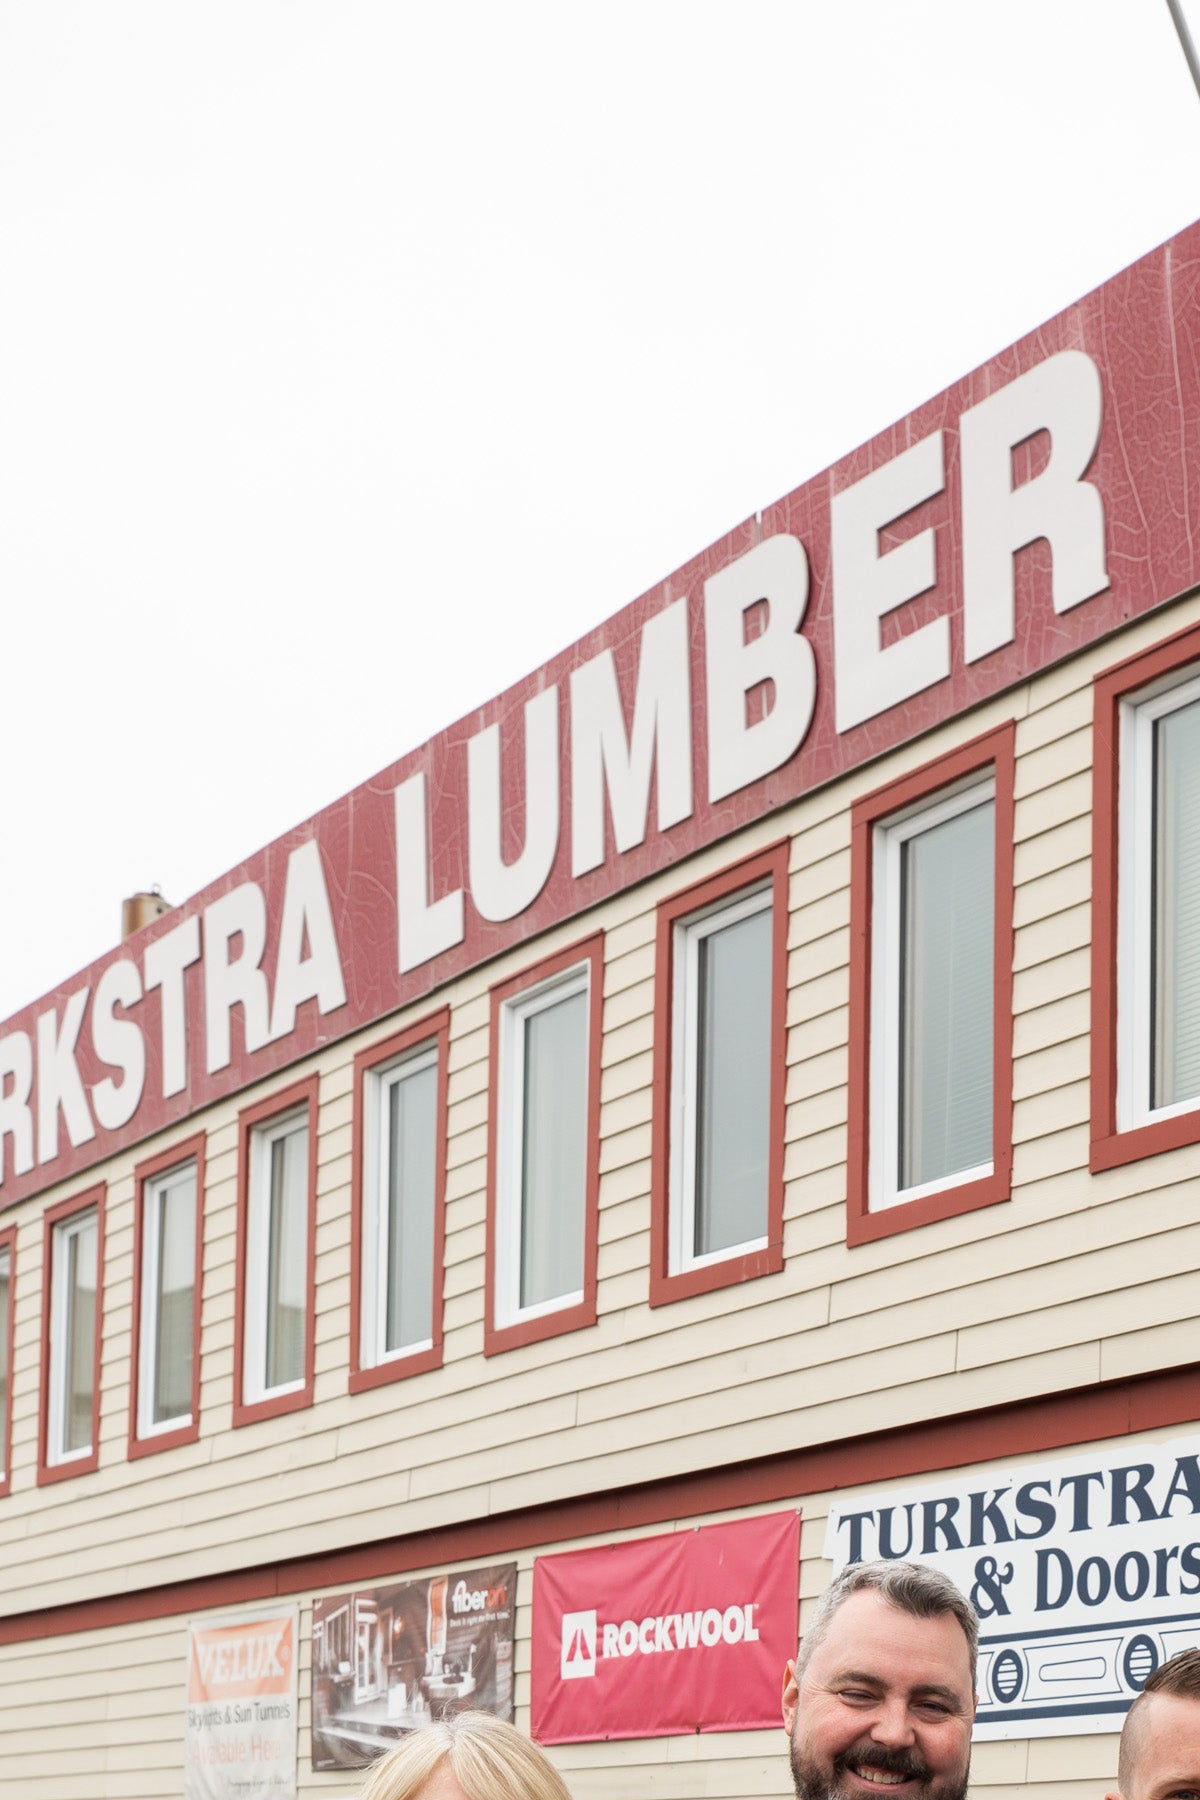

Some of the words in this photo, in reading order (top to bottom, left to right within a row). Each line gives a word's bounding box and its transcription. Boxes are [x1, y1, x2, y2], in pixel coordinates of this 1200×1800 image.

[394, 348, 1111, 975] LUMBER
[452, 1580, 507, 1614] fiberon
[969, 1555, 1014, 1619] &
[195, 1631, 285, 1686] VELUX
[602, 1604, 760, 1659] ROCKWOOL
[225, 1705, 232, 1724] &
[235, 1704, 252, 1724] Sun
[254, 1702, 291, 1722] Tunnels
